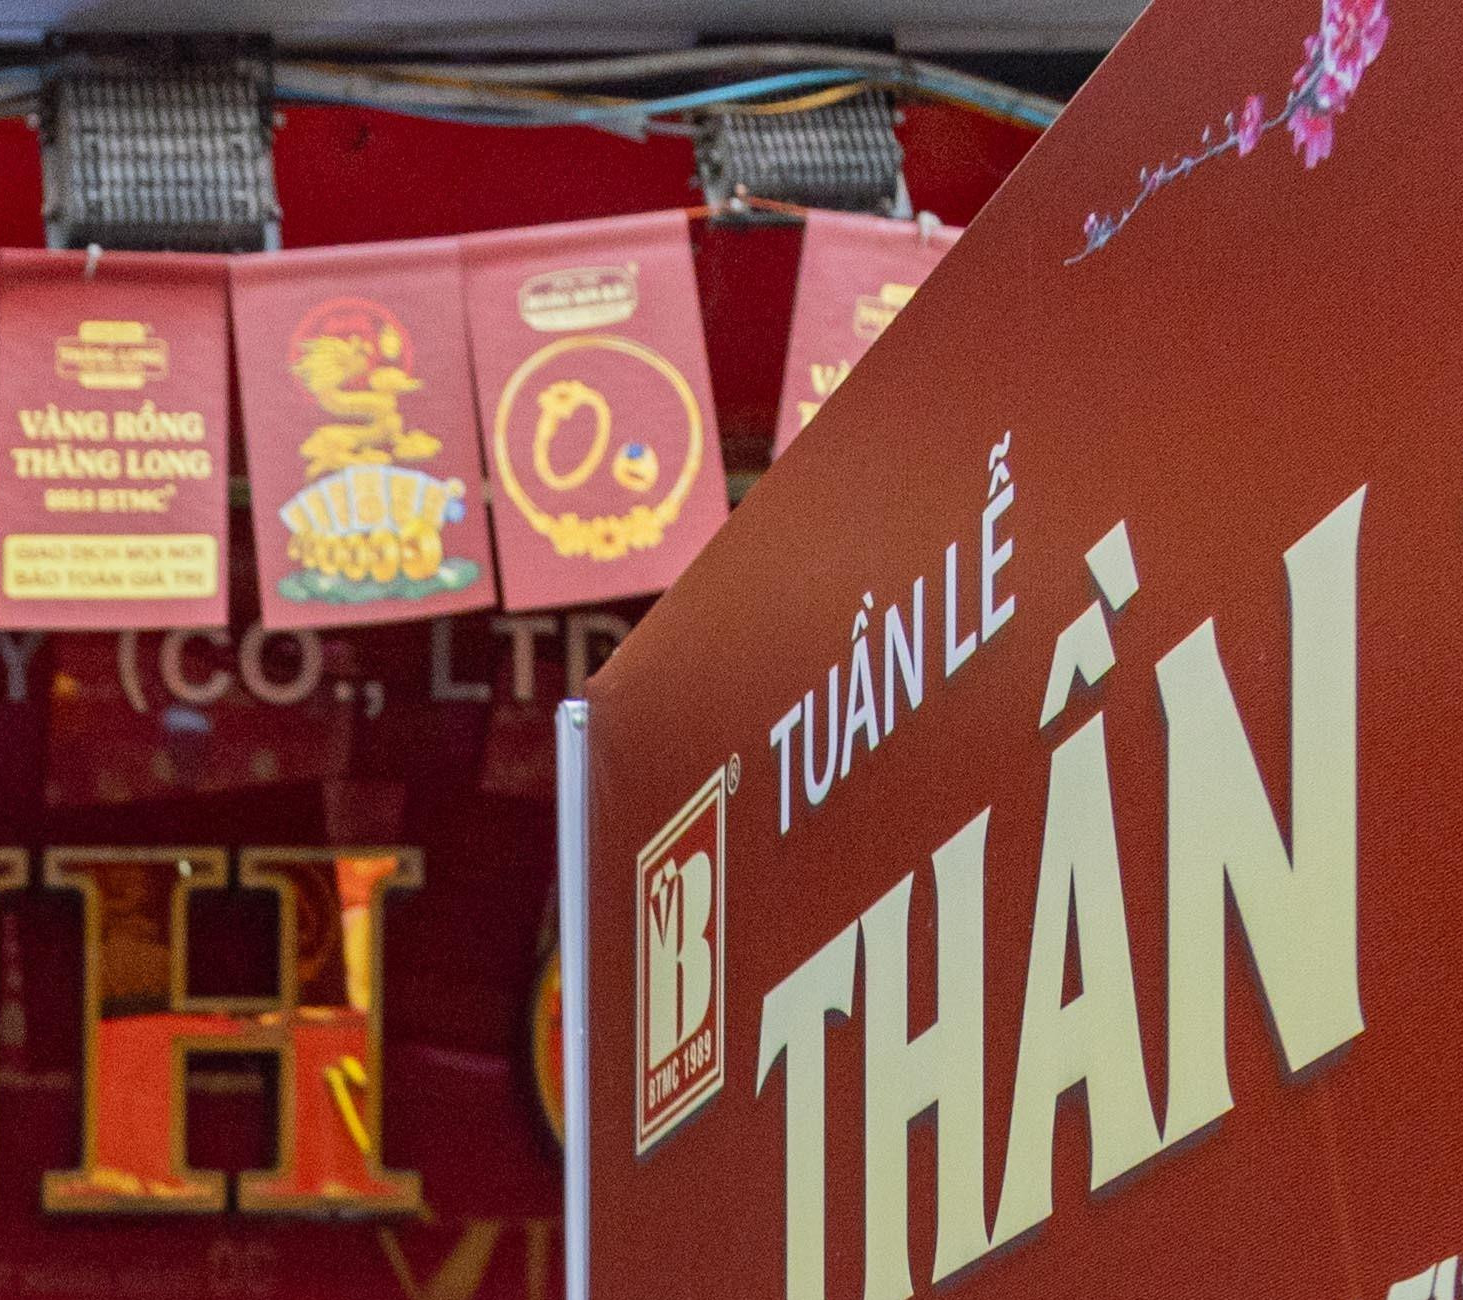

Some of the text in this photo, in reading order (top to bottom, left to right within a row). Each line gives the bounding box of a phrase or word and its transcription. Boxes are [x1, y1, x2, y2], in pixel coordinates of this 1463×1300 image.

[19, 400, 205, 442] VÀNG RỒNG
[10, 443, 212, 479] THĂNG LONG
[770, 431, 1016, 835] TUẦN LỄ
[682, 1028, 712, 1084] 1989
